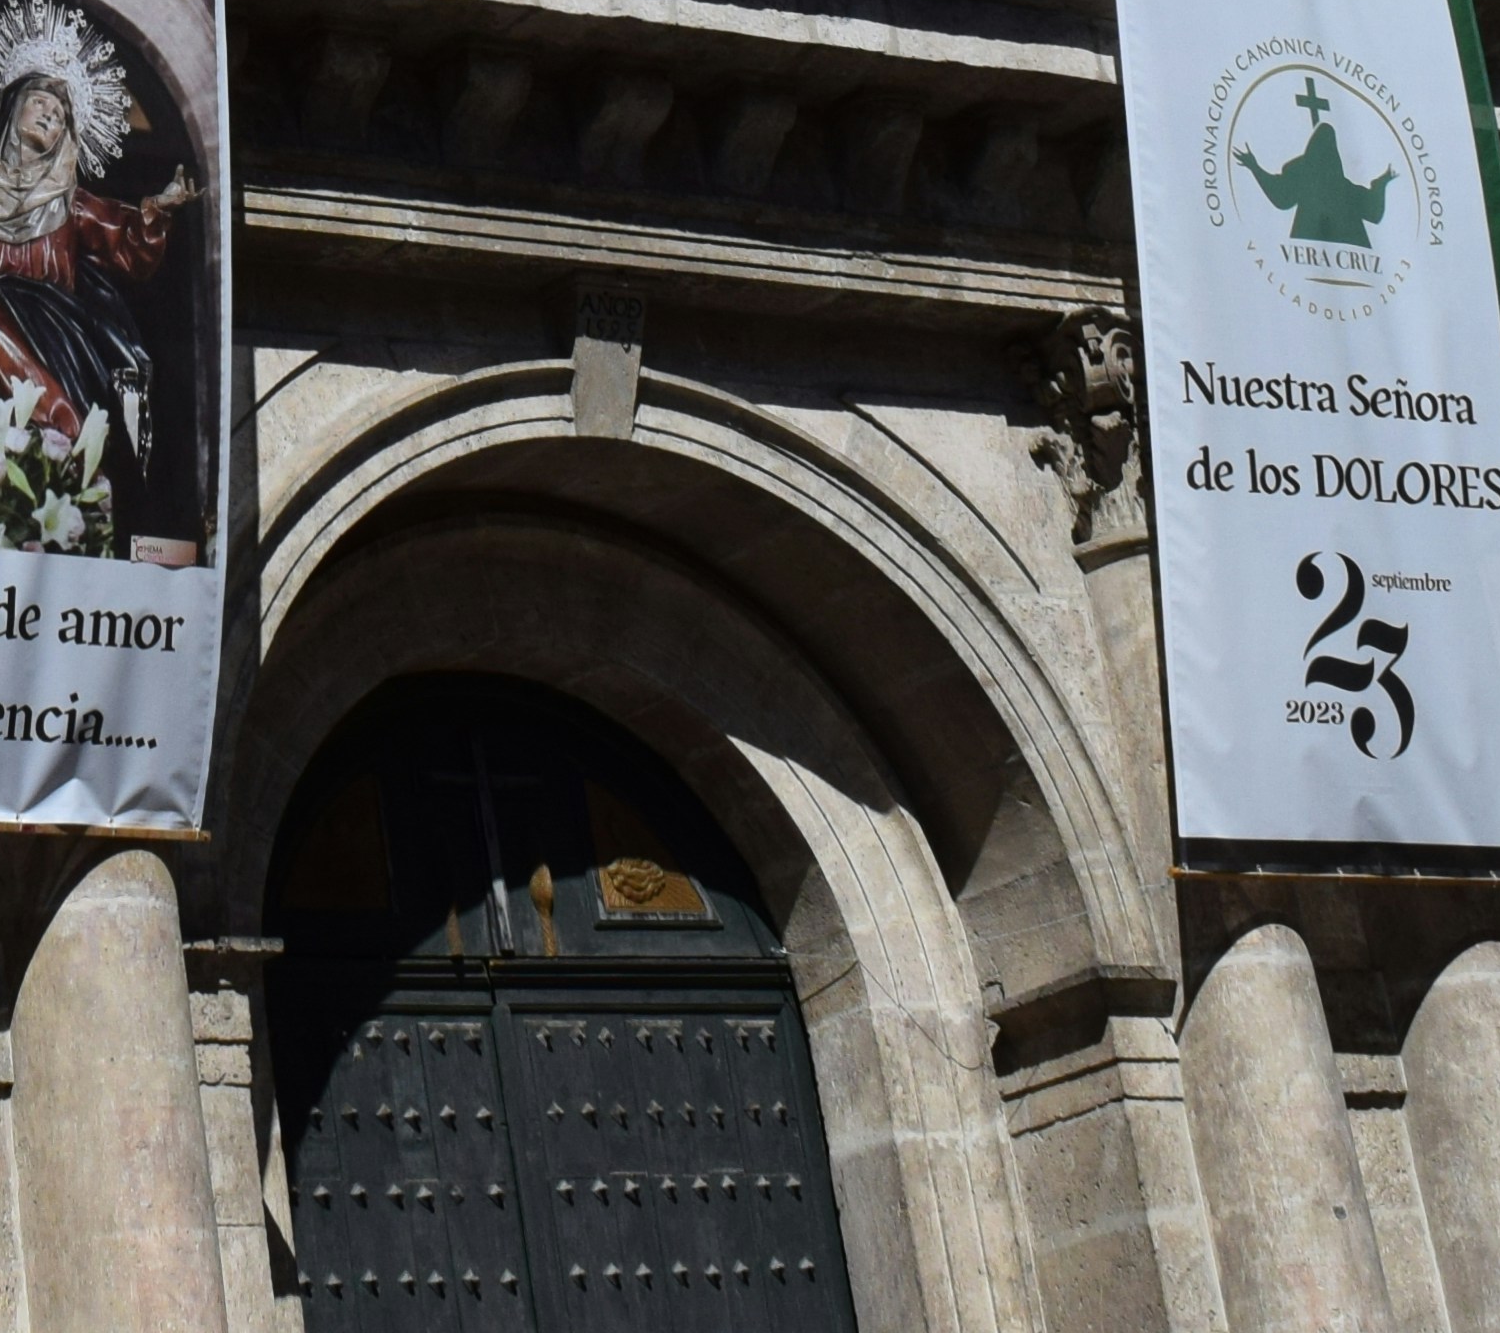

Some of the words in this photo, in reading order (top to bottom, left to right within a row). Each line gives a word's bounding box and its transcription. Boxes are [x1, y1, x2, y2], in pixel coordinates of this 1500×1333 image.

[1202, 68, 1237, 228] CORONACIÓN
[1234, 36, 1326, 72] CANÓNICA
[1332, 51, 1402, 113] VIRGEN
[1401, 117, 1444, 247] DOLOROSA
[1247, 239, 1373, 322] VALLADOLID
[1280, 243, 1331, 268] VERA
[1335, 248, 1383, 275] CRUZ
[1180, 360, 1339, 414] Nuestra
[1346, 374, 1477, 426] Señora
[1186, 445, 1234, 493] de
[1245, 448, 1301, 496] los
[57, 606, 186, 652] amor
[1295, 551, 1416, 761] 23
[1371, 571, 1453, 594] septiembre
[1285, 700, 1345, 726] 2023
